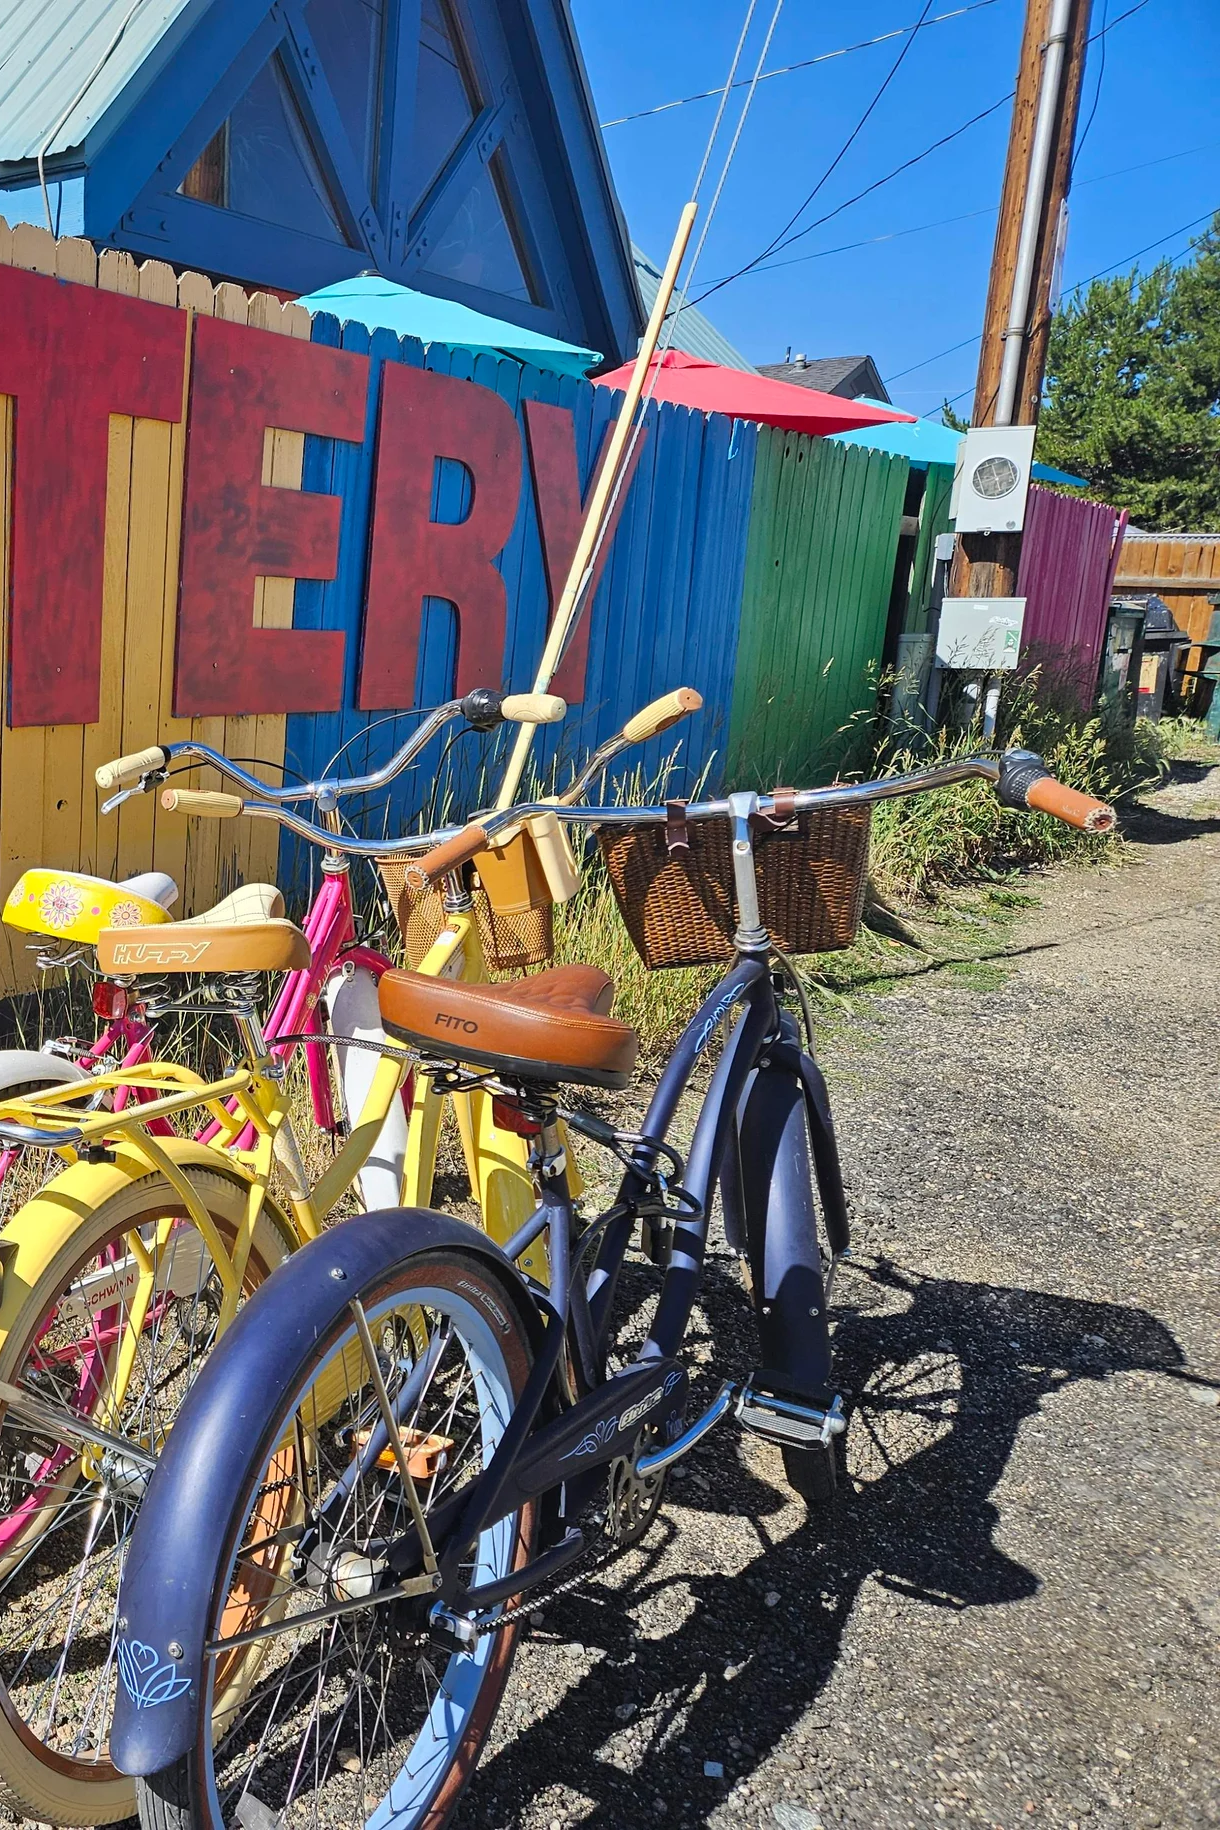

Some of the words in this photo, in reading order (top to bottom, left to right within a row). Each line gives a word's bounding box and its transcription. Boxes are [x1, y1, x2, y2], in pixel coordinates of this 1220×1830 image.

[113, 941, 212, 965] HUFFY
[434, 1012, 478, 1034] FITO
[83, 1273, 134, 1310] SCHWINN
